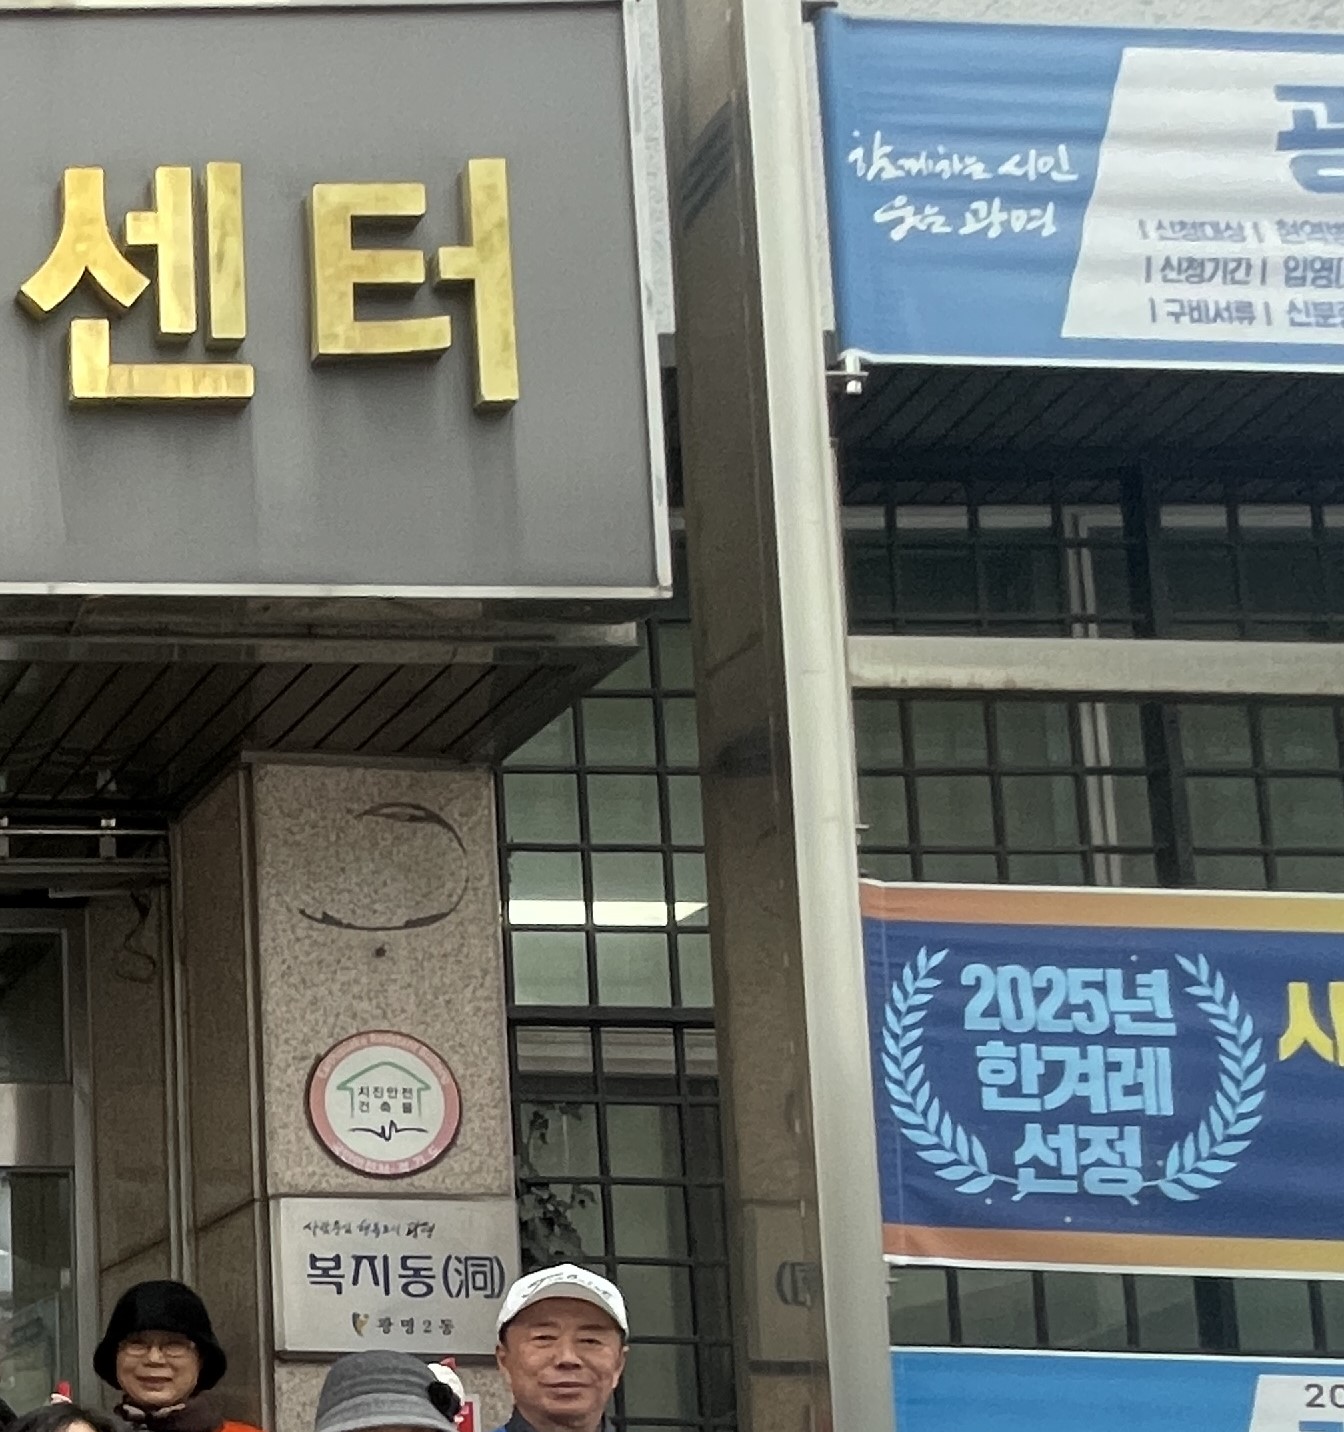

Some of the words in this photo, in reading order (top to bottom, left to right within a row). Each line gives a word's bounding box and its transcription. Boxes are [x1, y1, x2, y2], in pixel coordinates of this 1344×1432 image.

[992, 144, 1078, 181] 시민
[958, 197, 1058, 239] 광명
[960, 963, 1177, 1036] 2025년
[975, 1040, 1174, 1116] 한겨레
[1013, 1123, 1144, 1198] 선정
[306, 1253, 506, 1299] 복지동(洞)
